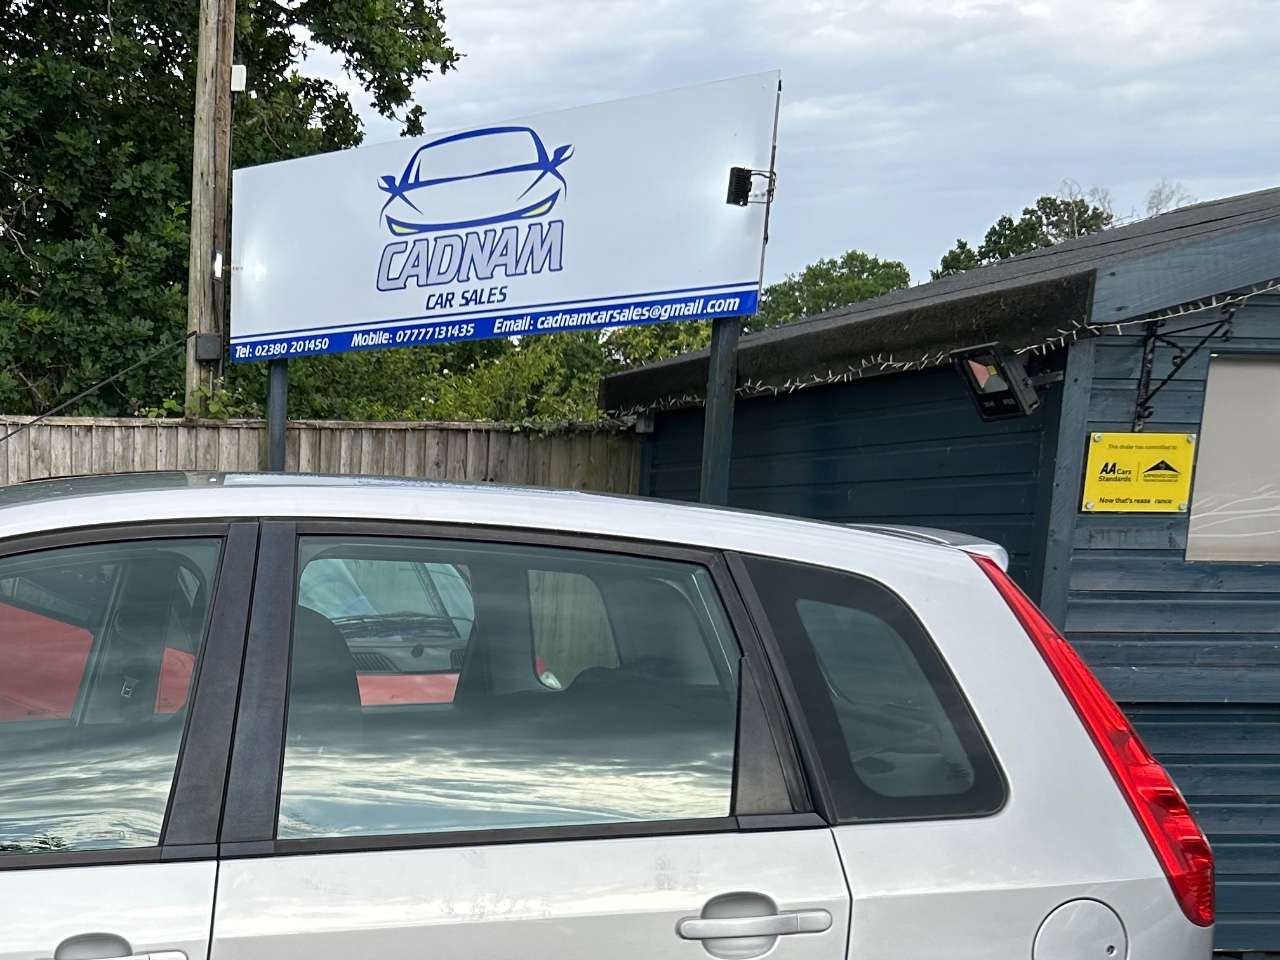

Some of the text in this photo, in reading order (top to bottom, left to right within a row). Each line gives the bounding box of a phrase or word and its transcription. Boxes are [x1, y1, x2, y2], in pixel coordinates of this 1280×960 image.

[376, 219, 564, 291] CADNAM
[425, 286, 508, 310] CAR SALES
[235, 297, 740, 358] Tel: 02380 201450 Mobile: 07777131435 Email: cadnamcarsales@gmail.com
[1100, 462, 1117, 475] AA
[1098, 496, 1114, 504] Now
